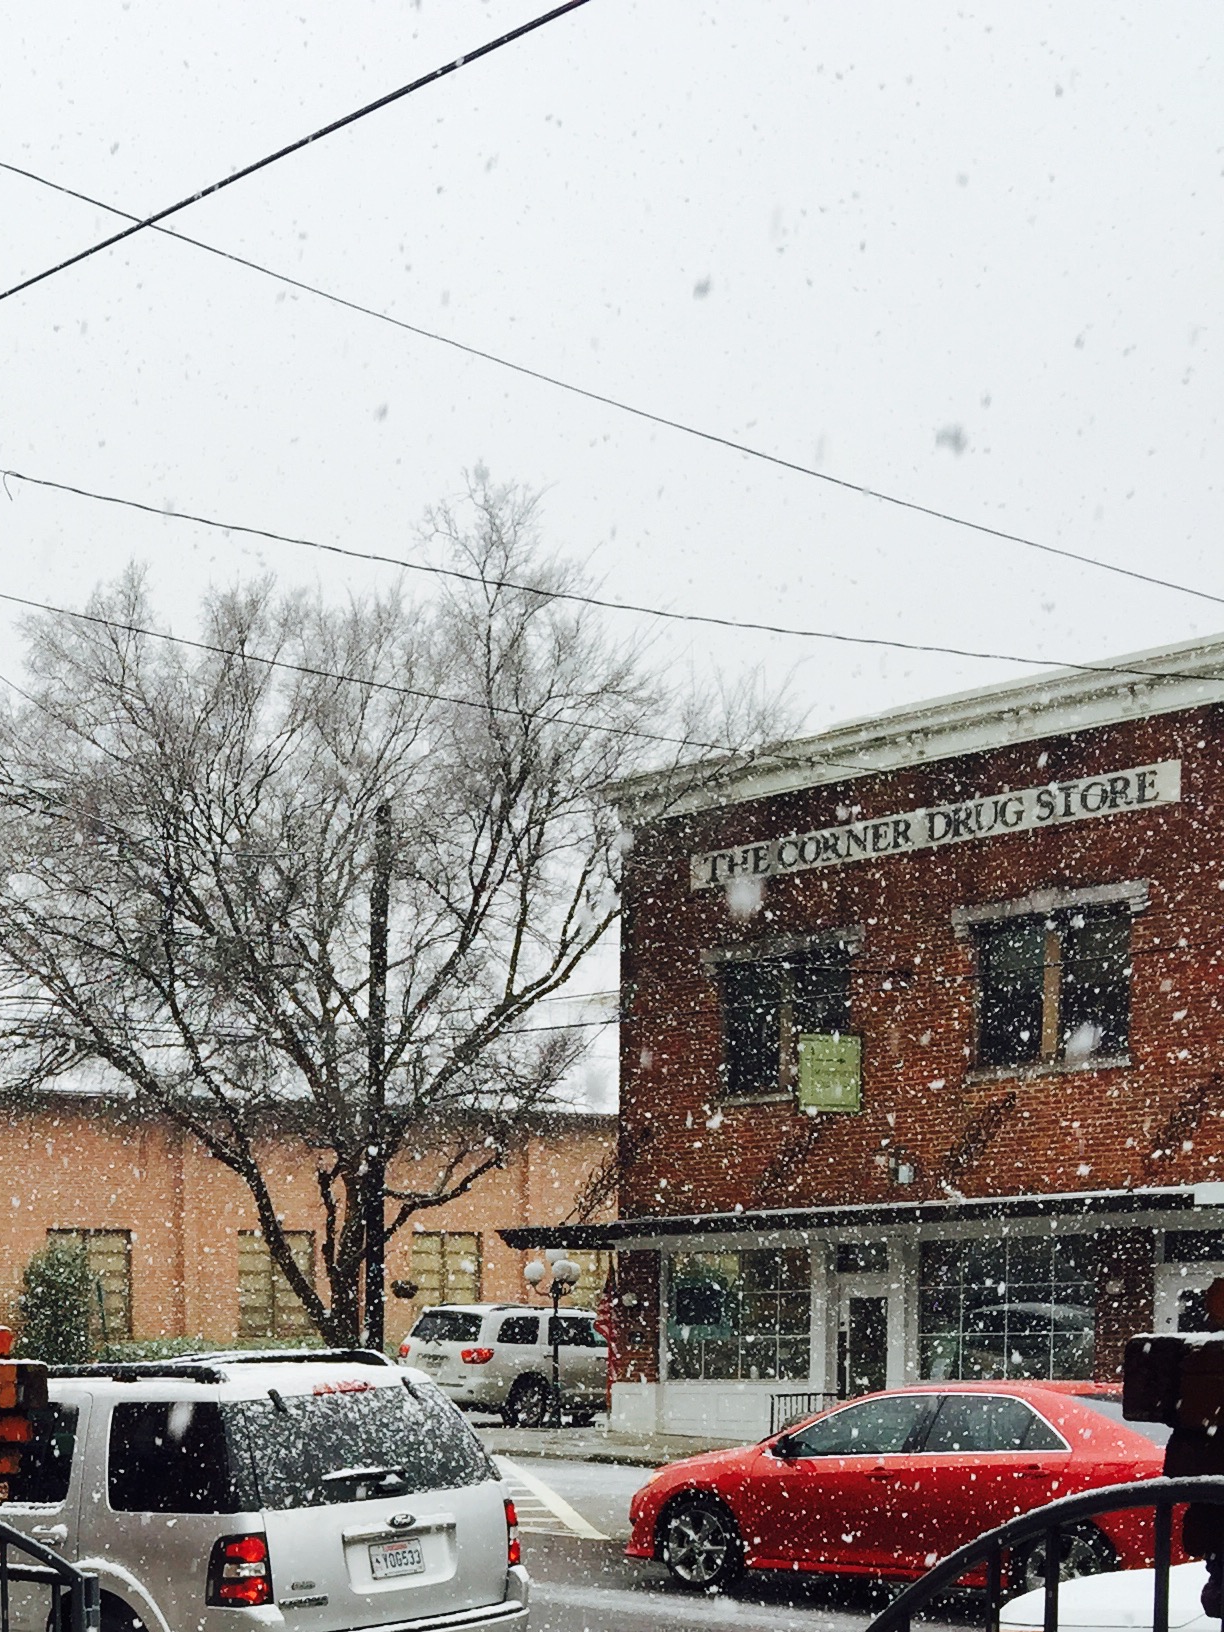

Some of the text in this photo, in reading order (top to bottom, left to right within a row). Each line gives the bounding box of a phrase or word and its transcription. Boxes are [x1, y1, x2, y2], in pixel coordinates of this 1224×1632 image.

[705, 770, 1159, 883] THE CORNER DRUG STORE
